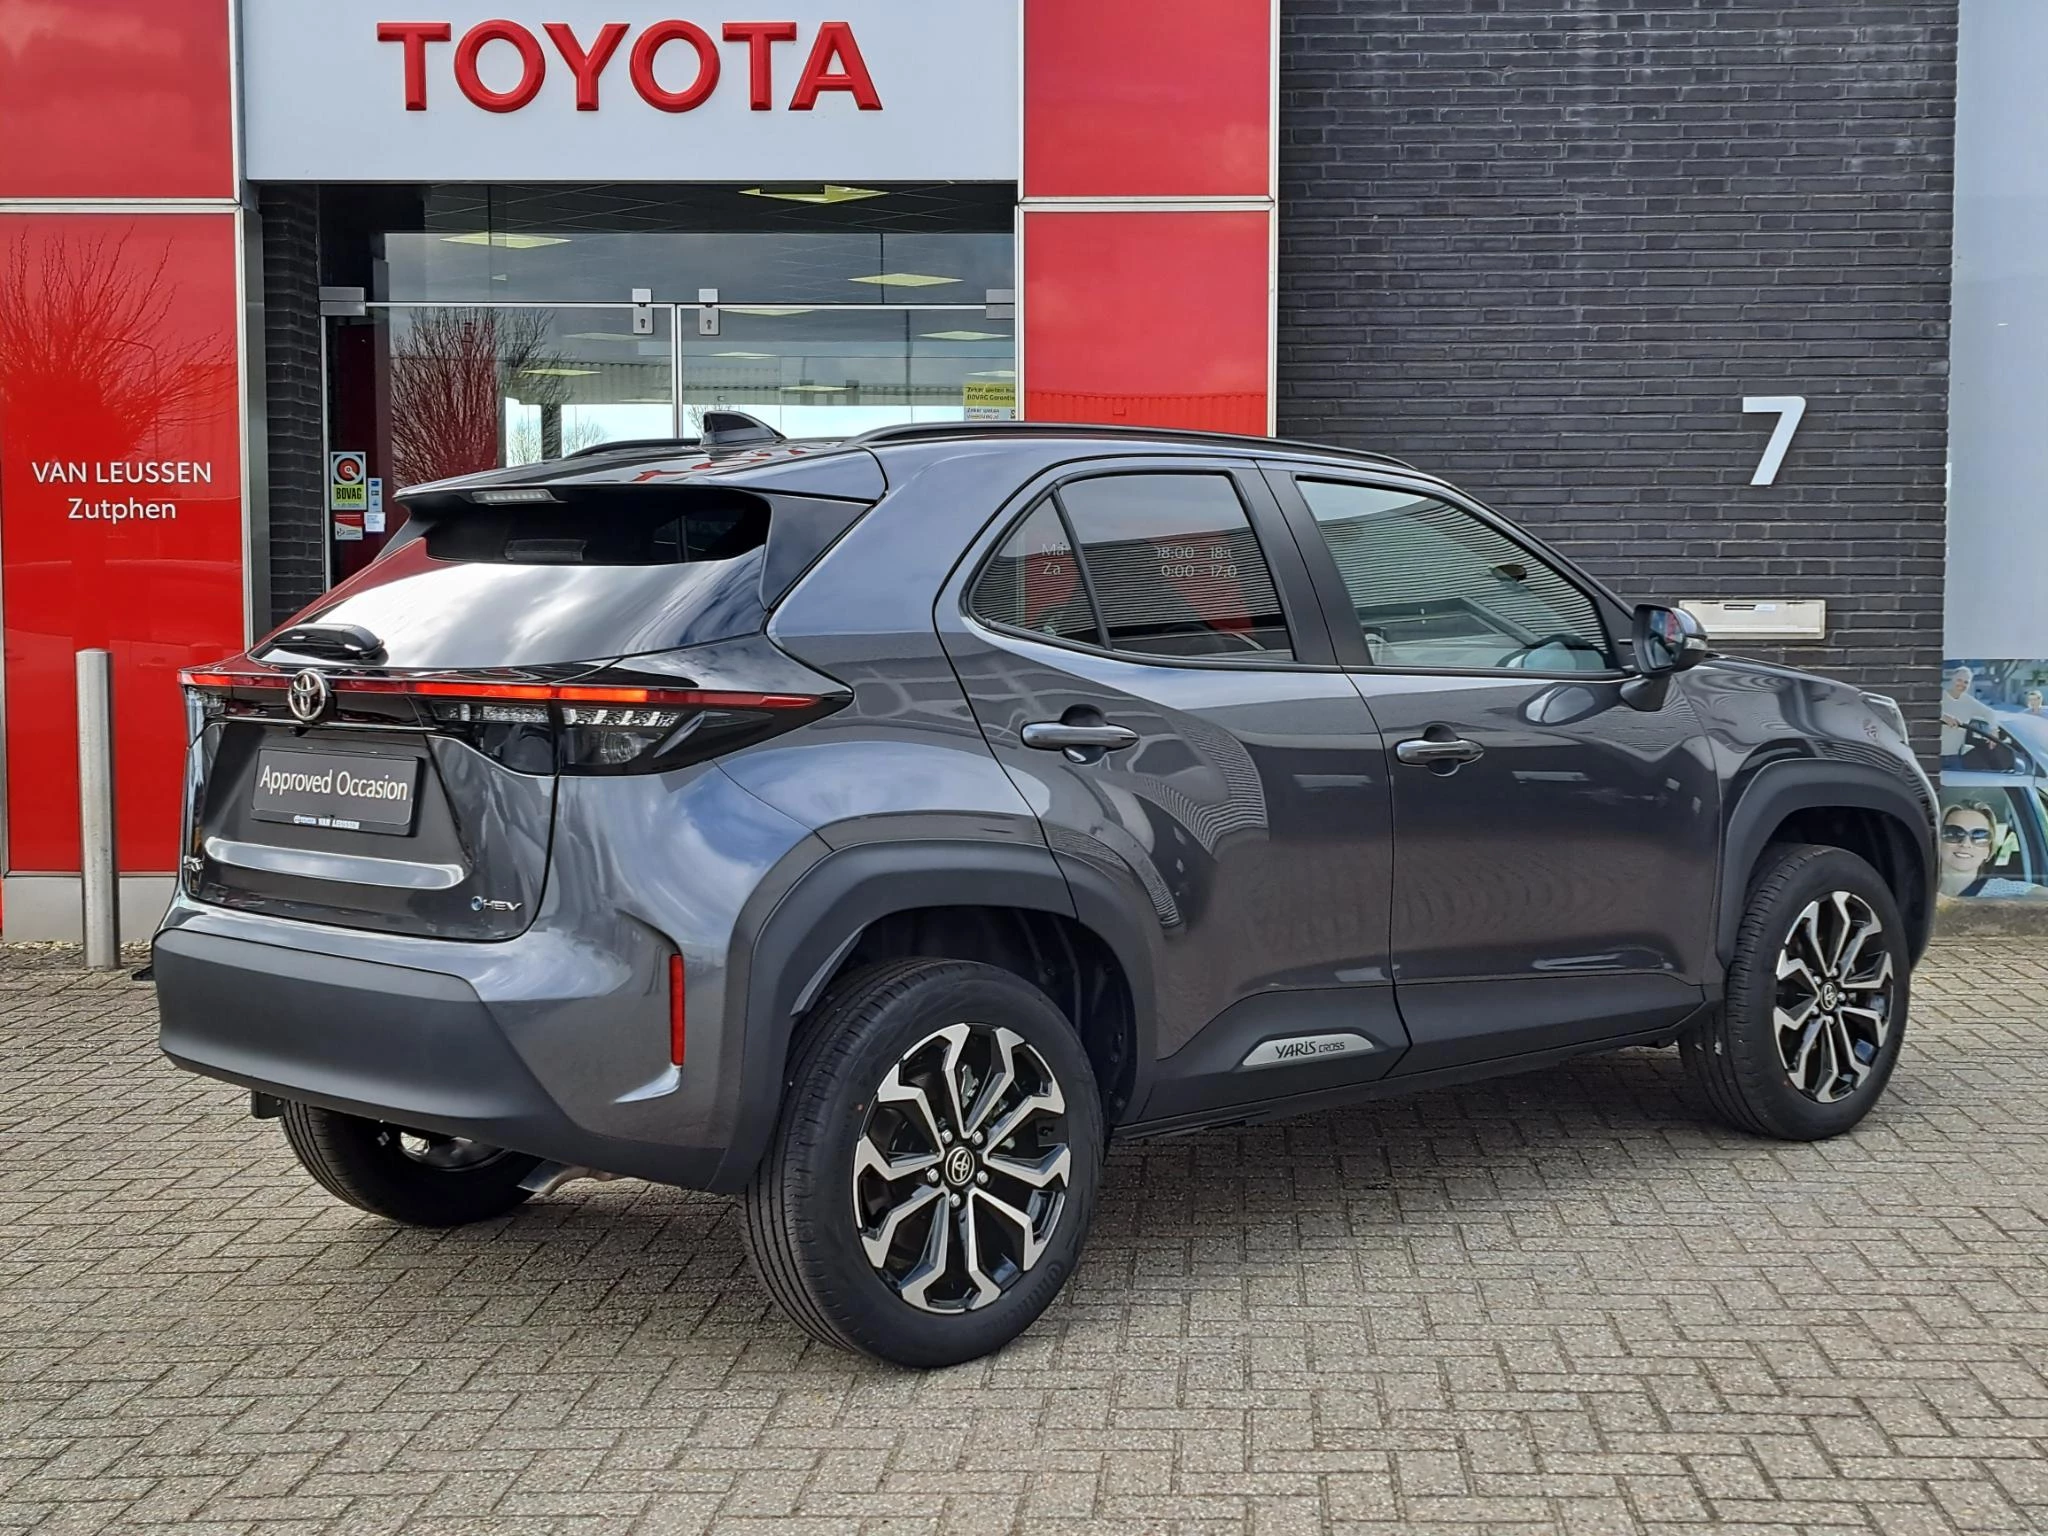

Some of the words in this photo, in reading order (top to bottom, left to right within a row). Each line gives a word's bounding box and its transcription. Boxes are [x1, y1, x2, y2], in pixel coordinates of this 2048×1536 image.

[377, 19, 883, 113] TOYOTA
[1742, 396, 1807, 486] 7
[31, 461, 87, 484] VAN
[96, 461, 211, 484] LEUSSEN
[336, 487, 362, 500] BOVAG
[67, 496, 177, 525] Zutphen
[1043, 562, 1061, 575] Za
[259, 765, 333, 796] Approved
[337, 770, 408, 801] Occasion
[483, 899, 522, 911] HEV
[1319, 1042, 1345, 1053] CROSS
